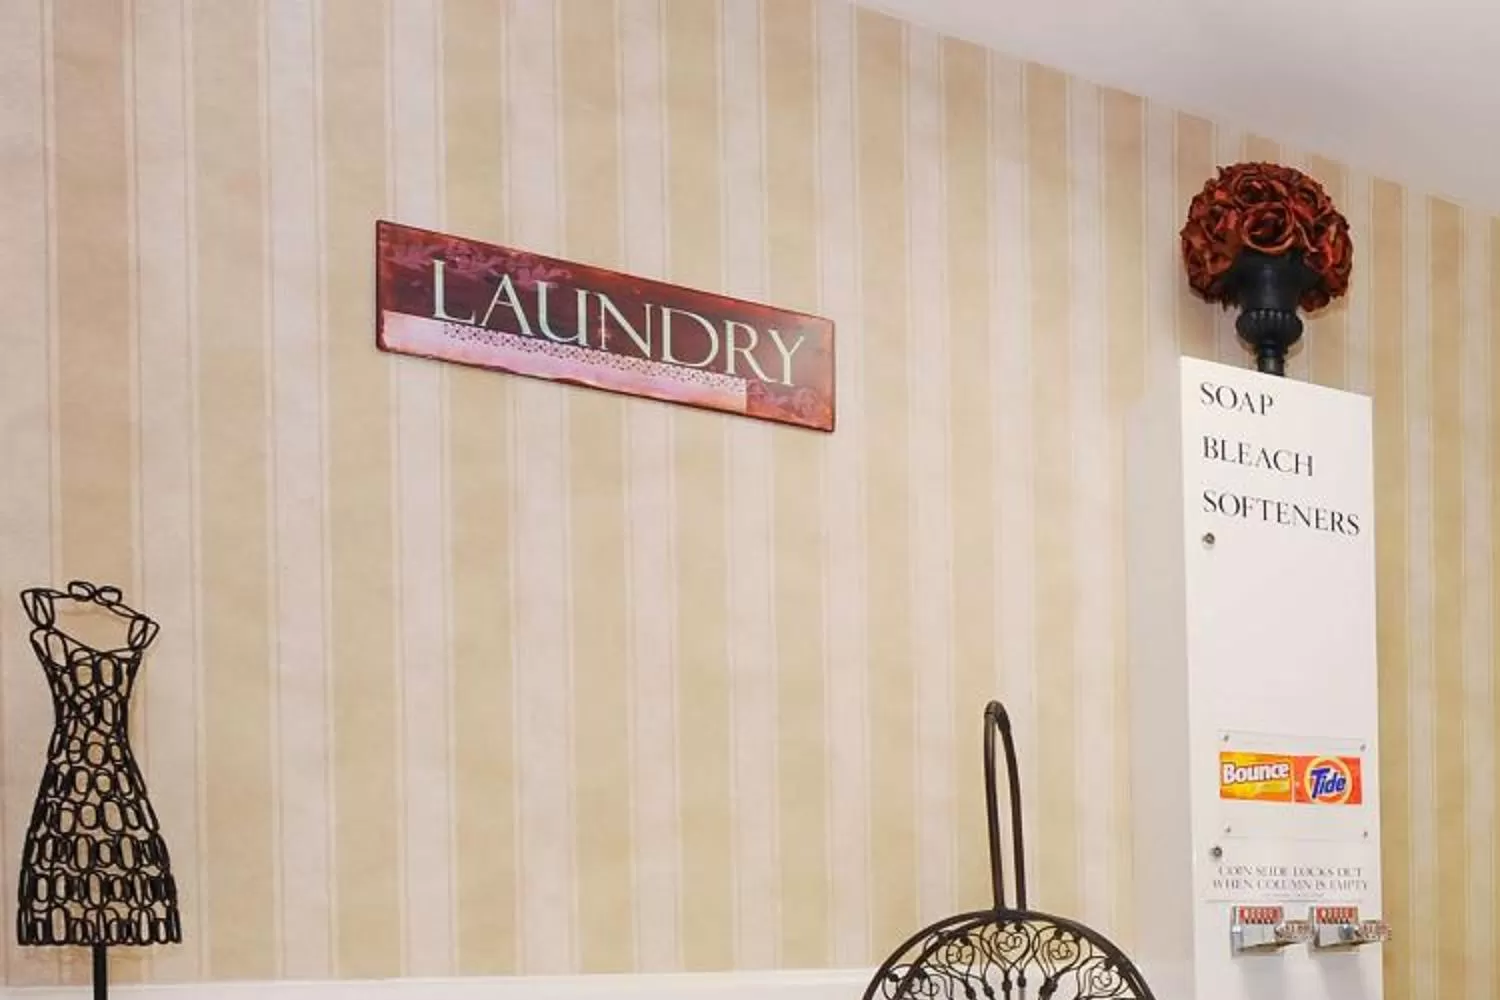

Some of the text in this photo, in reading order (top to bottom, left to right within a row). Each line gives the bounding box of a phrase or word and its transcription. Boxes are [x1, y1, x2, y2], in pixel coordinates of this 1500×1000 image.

[432, 259, 806, 386] LAUNDRY
[1200, 381, 1274, 416] SOAP
[1203, 435, 1314, 477] BLEACH
[1203, 489, 1361, 536] SOFTENERS
[1222, 762, 1290, 785] Bounce
[1310, 767, 1347, 799] Tide
